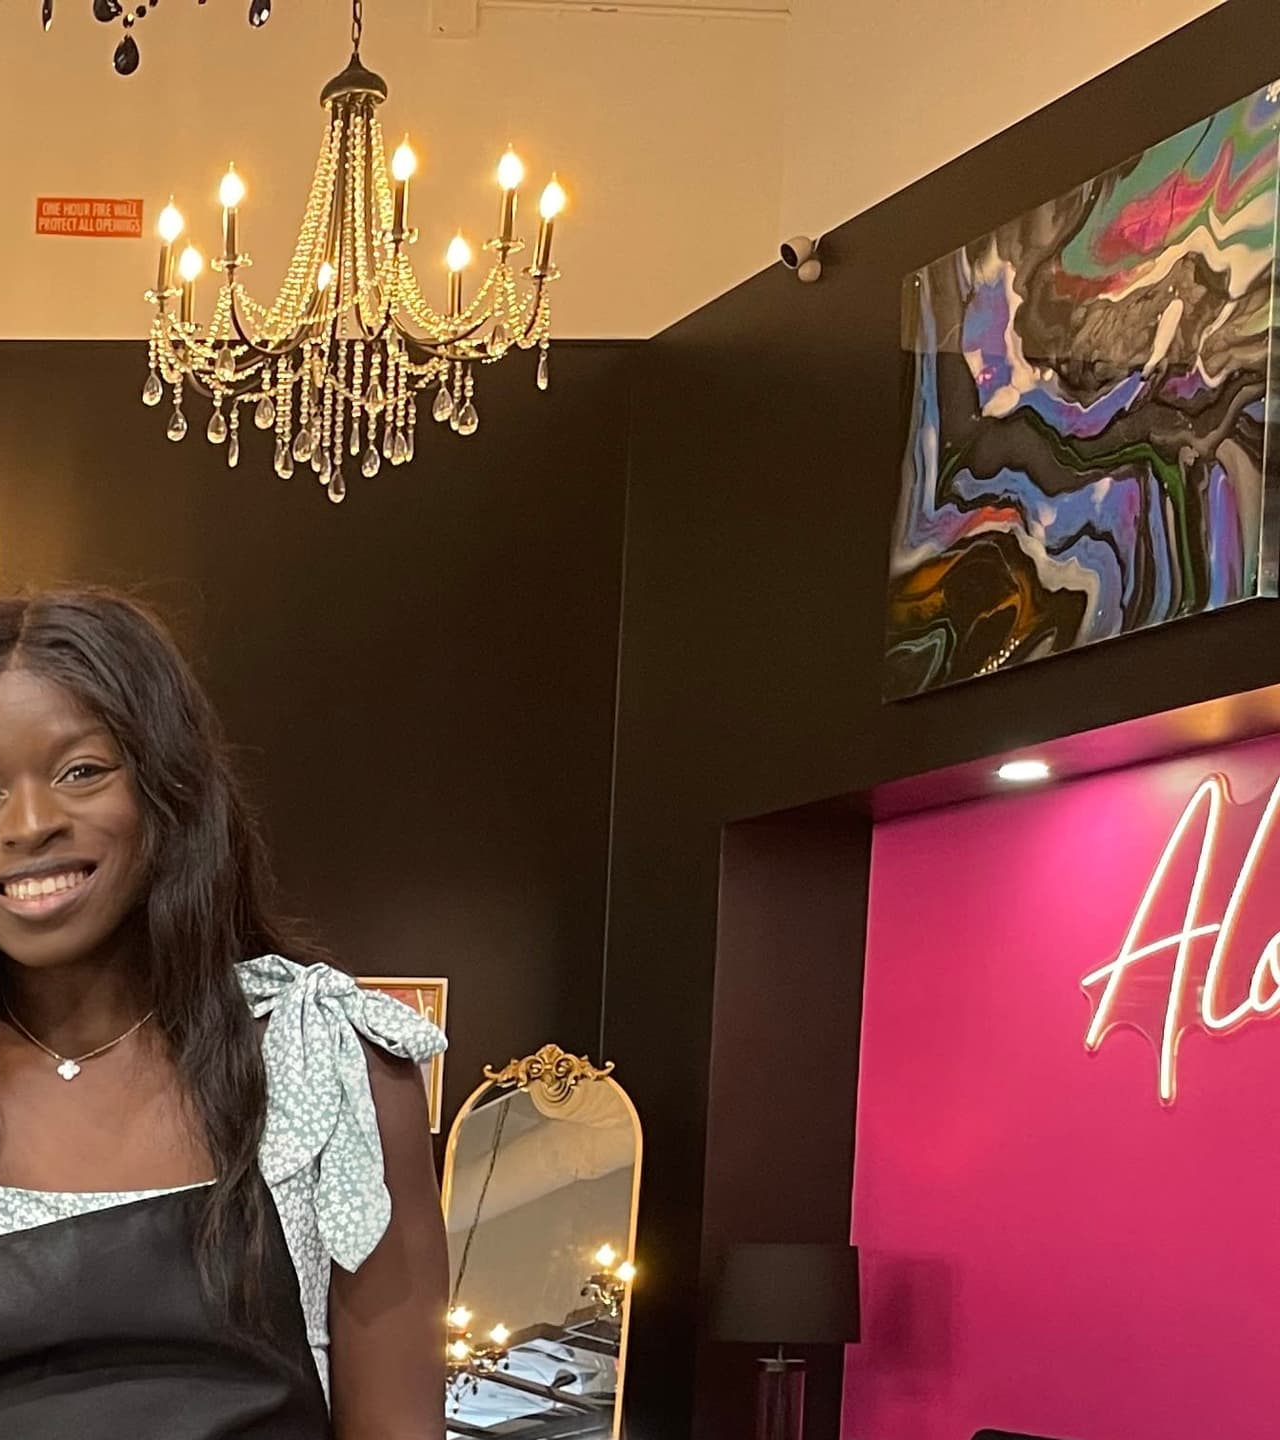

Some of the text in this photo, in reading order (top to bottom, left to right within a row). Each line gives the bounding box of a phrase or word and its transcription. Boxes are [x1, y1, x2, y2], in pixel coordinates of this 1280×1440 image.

[42, 202, 137, 217] ONE HOUR FIRE WALL
[39, 217, 139, 232] PROTECT ALL OPENINGS
